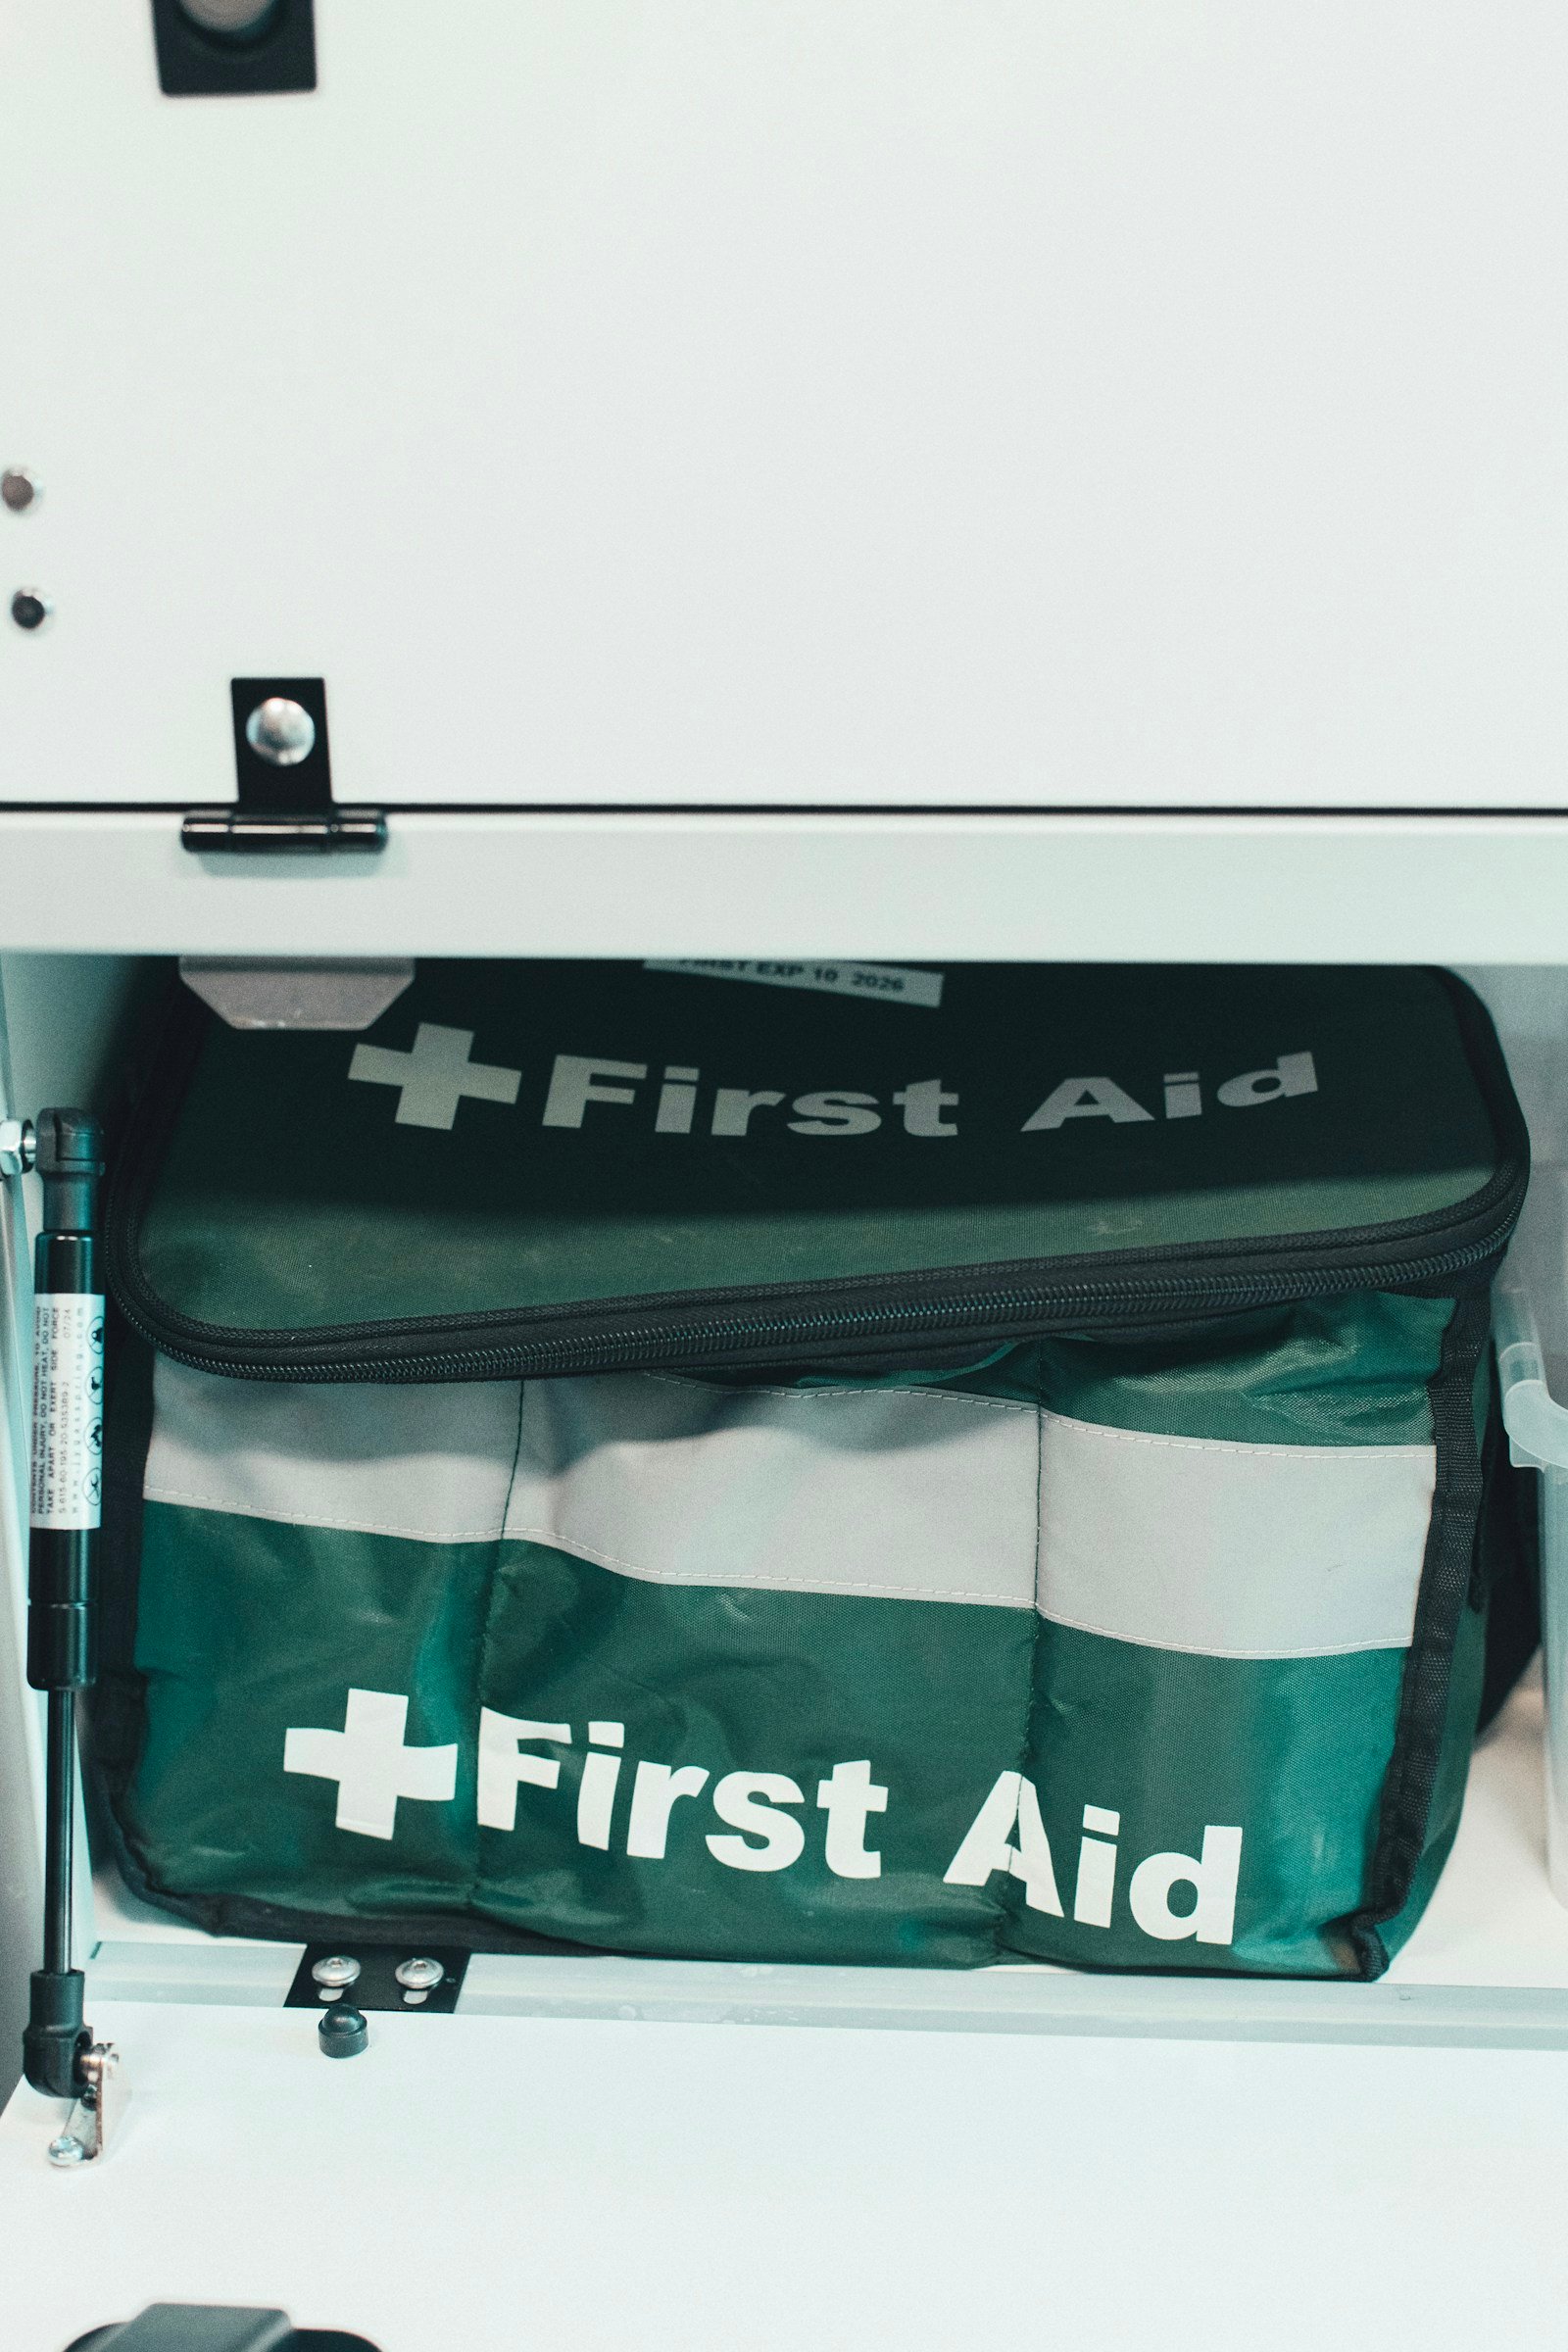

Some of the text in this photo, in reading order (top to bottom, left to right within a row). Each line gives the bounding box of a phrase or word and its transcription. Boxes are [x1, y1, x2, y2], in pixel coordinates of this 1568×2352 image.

[756, 960, 804, 976] EXP
[814, 965, 838, 982] 10
[851, 970, 904, 992] 2026
[542, 1051, 1318, 1137] First Aid
[42, 1331, 49, 1345] DO
[41, 1403, 47, 1417] DO
[49, 1423, 56, 1437] OR
[477, 1706, 1243, 1945] First Aid
